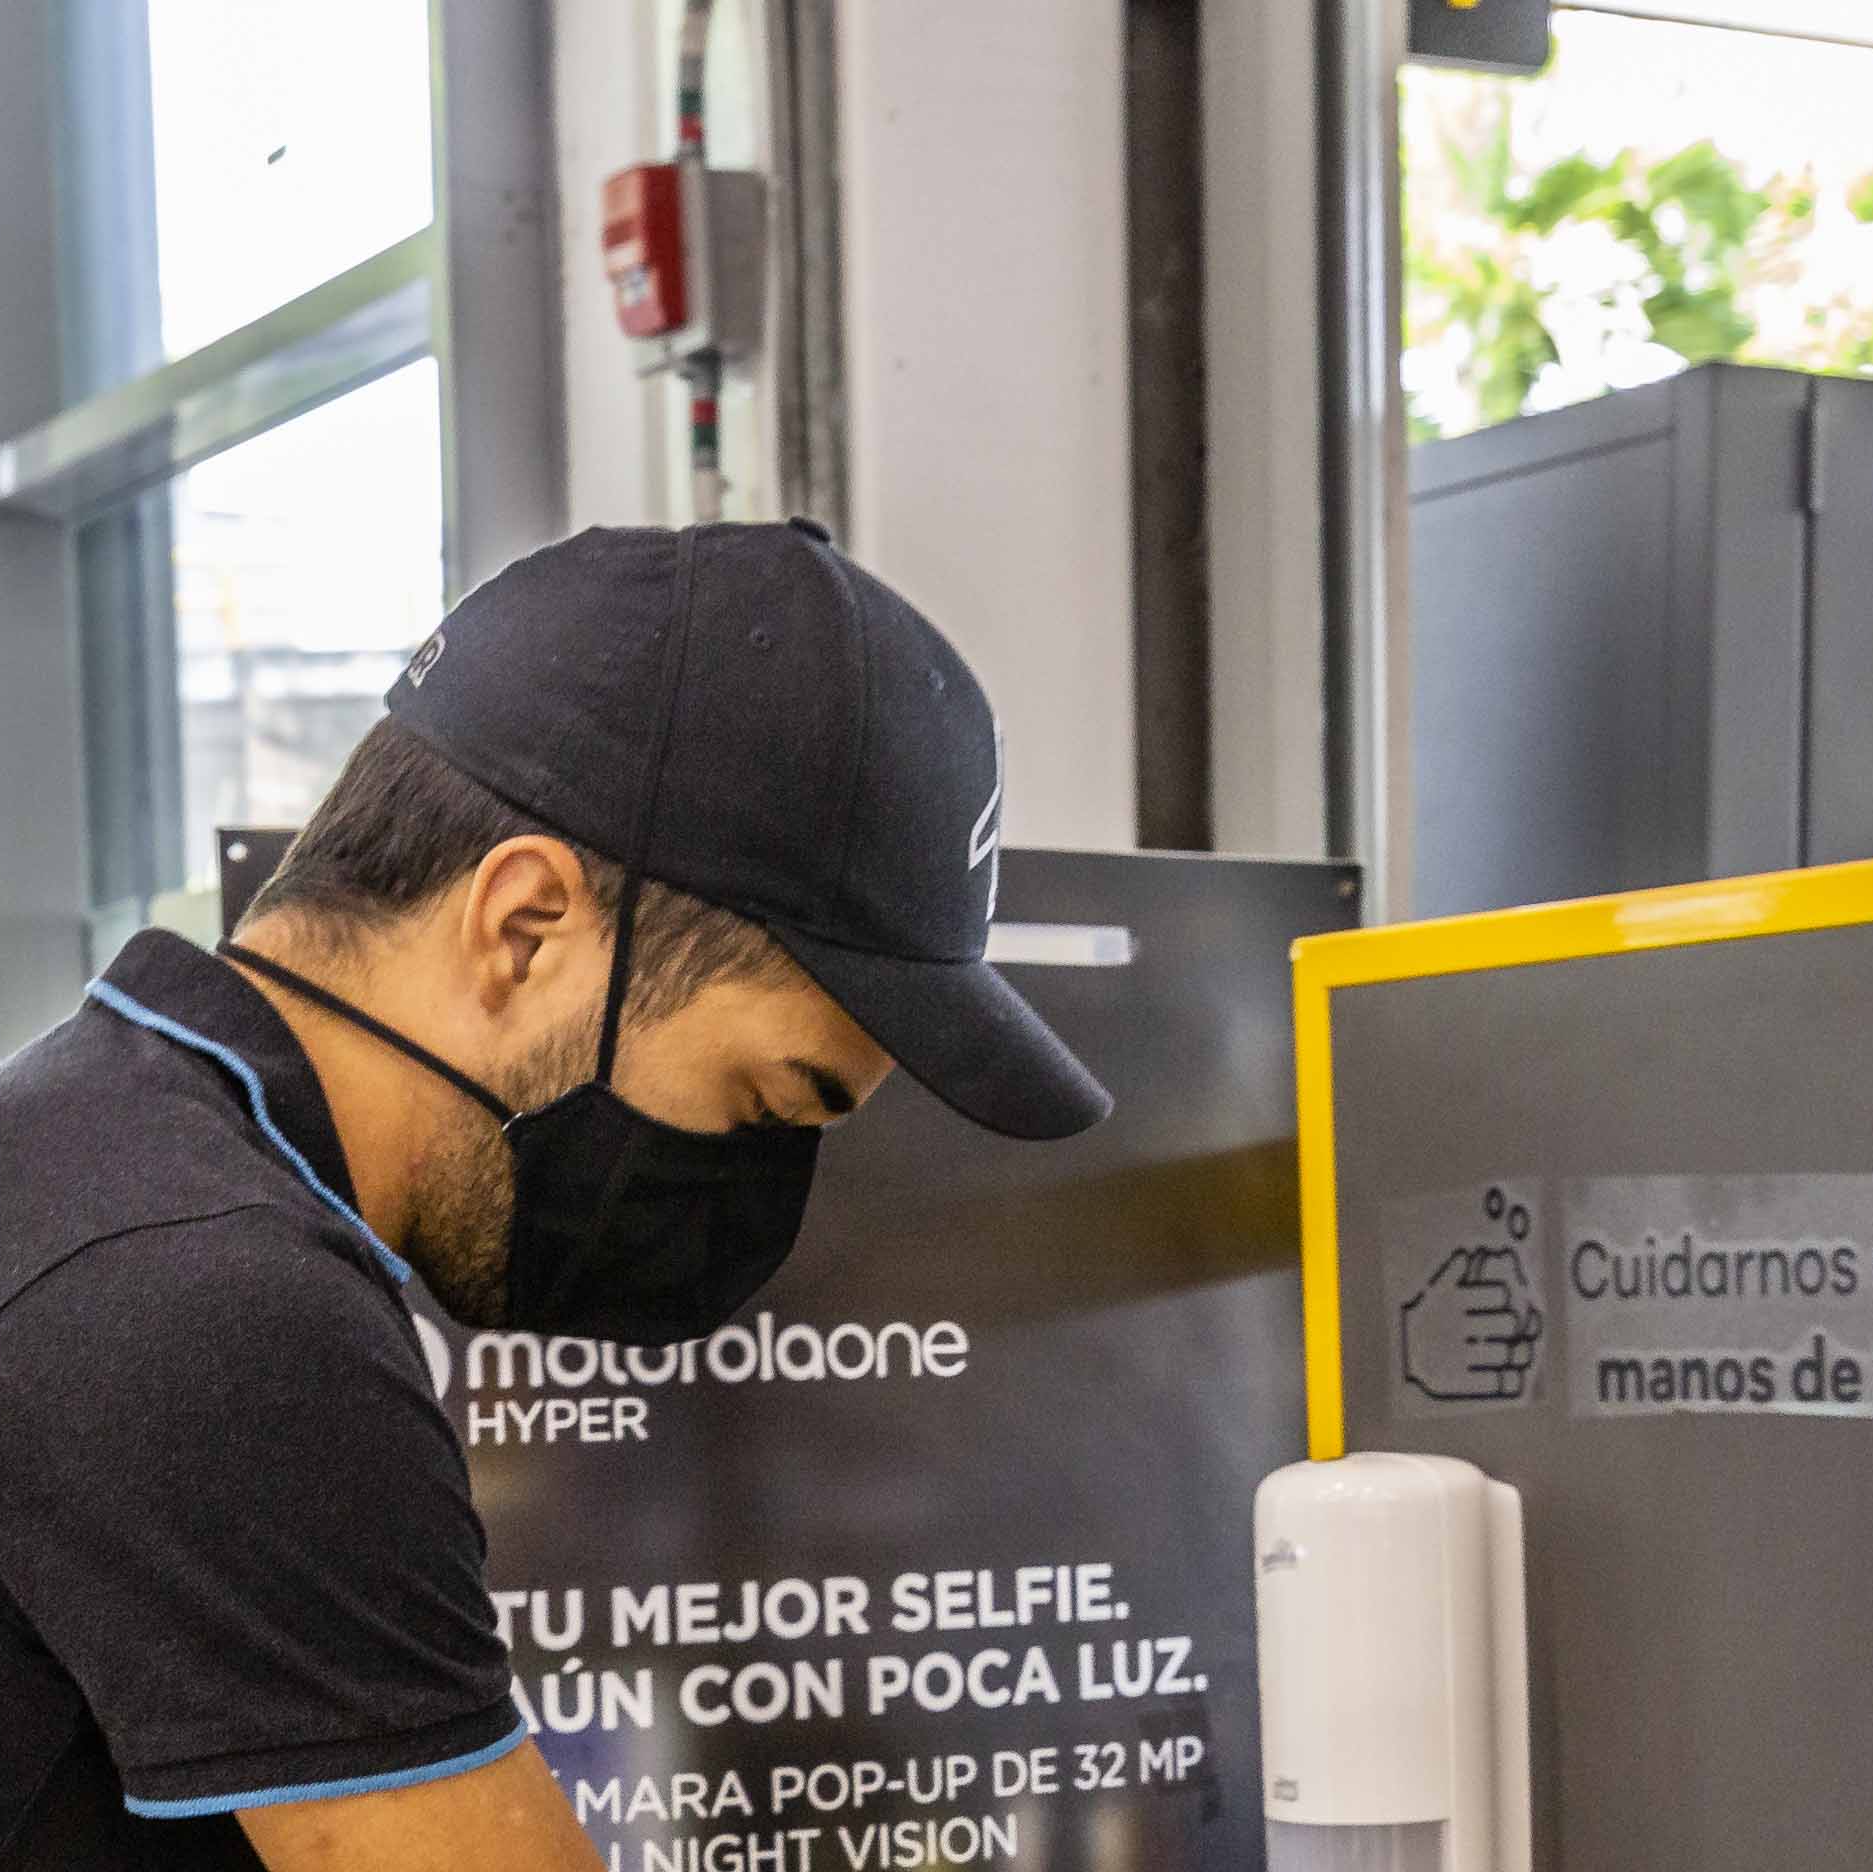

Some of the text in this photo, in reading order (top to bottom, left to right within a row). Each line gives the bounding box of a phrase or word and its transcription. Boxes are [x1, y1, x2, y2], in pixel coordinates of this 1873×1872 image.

[1571, 1233, 1859, 1300] Cuidarnos
[1597, 1353, 1776, 1404] manos
[1791, 1332, 1862, 1403] de
[467, 1396, 649, 1447] HYPER
[488, 1561, 1130, 1653] TU MEJOR SELFIE.
[678, 1657, 846, 1728] CON
[868, 1646, 1063, 1717] POCA
[1077, 1636, 1210, 1706] LUZ.
[552, 1735, 1204, 1827] MARA POP-UP DE 32 MP
